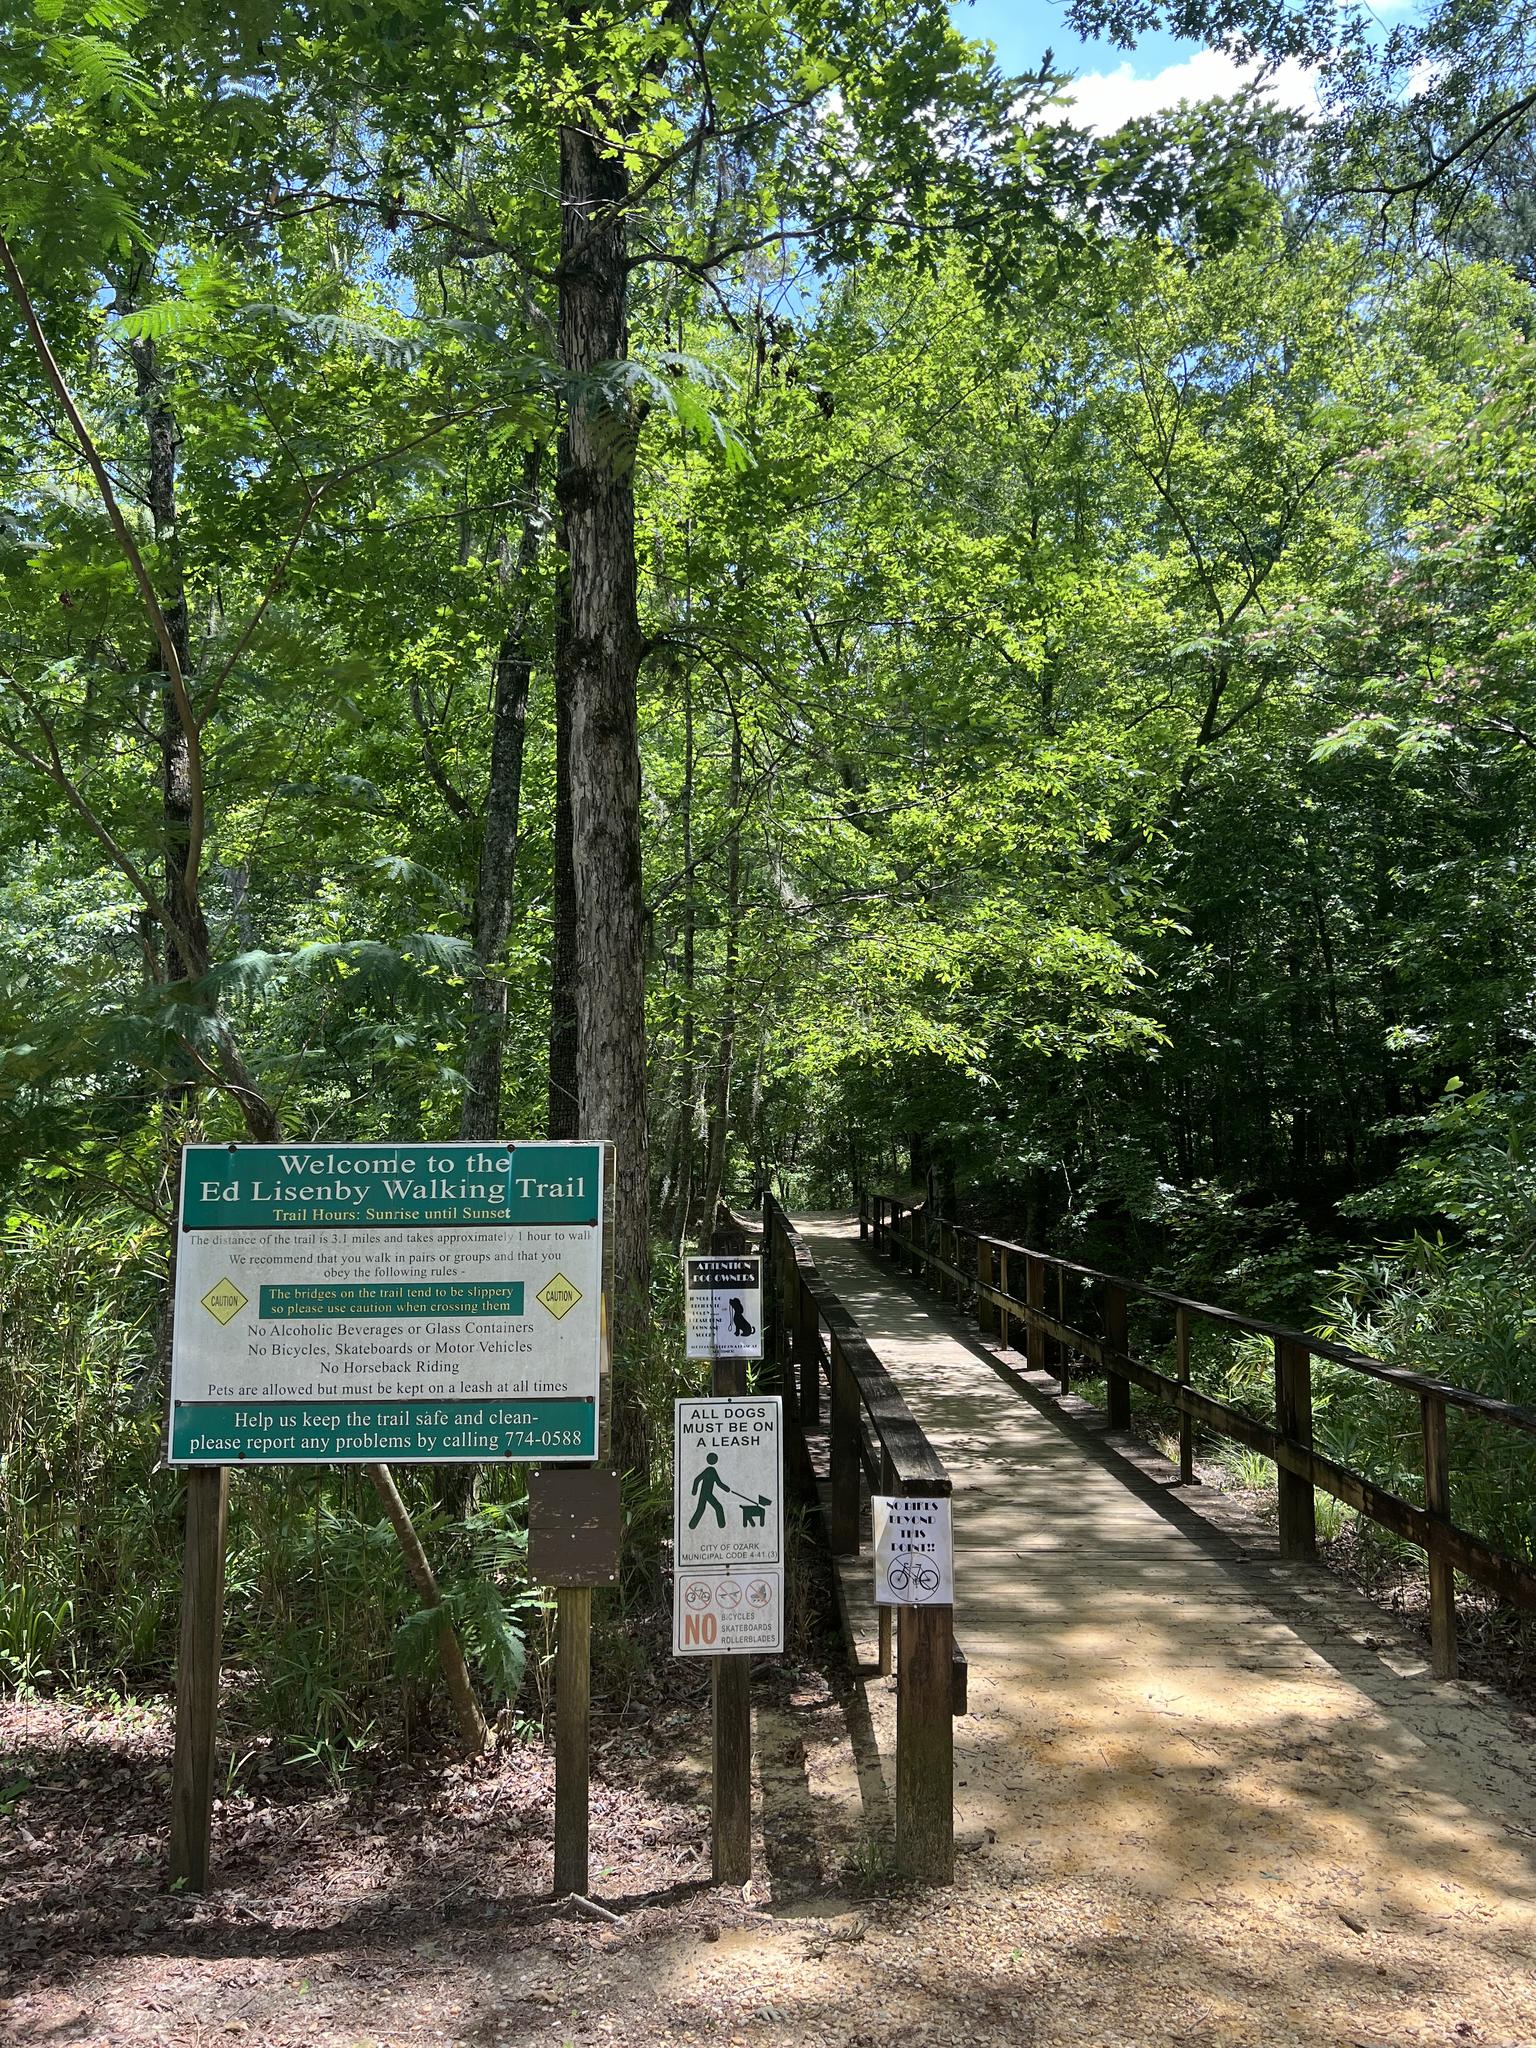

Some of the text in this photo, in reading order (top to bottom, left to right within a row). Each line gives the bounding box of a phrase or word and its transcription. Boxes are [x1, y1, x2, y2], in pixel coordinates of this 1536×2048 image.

[278, 1153, 510, 1175] Welcome to the
[200, 1177, 585, 1205] Ed Lisenby Walking Trail
[273, 1207, 511, 1221] Trail Hours: Sunrise until Sunset
[190, 1230, 593, 1245] The distance of the trail is 3.1 miles and takes approximately 1 hour to walk
[229, 1251, 561, 1266] We recommend that you walk in pairs or groups and that you
[696, 1262, 751, 1270] ATTENTION
[323, 1268, 350, 1279] obey
[354, 1267, 370, 1277] the
[374, 1266, 427, 1278] following
[431, 1266, 457, 1276] rules
[693, 1274, 755, 1282] DOG OWNERS
[269, 1286, 514, 1301] The bridges on the trail tend to be slippery
[545, 1291, 573, 1301] CAUTION
[211, 1295, 238, 1307] CAUTION
[271, 1300, 510, 1315] so please use caution when crossing them
[248, 1322, 534, 1337] No Alcoholic Beverages or Glass Containers
[248, 1341, 532, 1358] No Bicycles, Skateboards or Motor Vehicles
[320, 1361, 459, 1375] No Horseback Riding
[208, 1380, 568, 1396] Pets are allowed but must be kept on a leash at all times
[691, 1408, 766, 1419] ALL DOGS
[235, 1410, 539, 1431] Help us keep the trail safe and clean-
[683, 1421, 774, 1433] MUST BE ON
[190, 1431, 582, 1453] please report any problems by calling 774-0588
[696, 1436, 760, 1447] A LEASH
[886, 1502, 938, 1511] NO BIKES
[889, 1515, 937, 1524] BEYOND
[900, 1530, 926, 1538] THIS
[891, 1543, 935, 1551] POINT!!
[682, 1552, 723, 1560] MUNICIPAL
[721, 1612, 755, 1620] BICYCLES
[685, 1613, 717, 1645] NO
[721, 1623, 772, 1633] SKATEBOARDS
[721, 1634, 776, 1644] ROLLERBLADES
